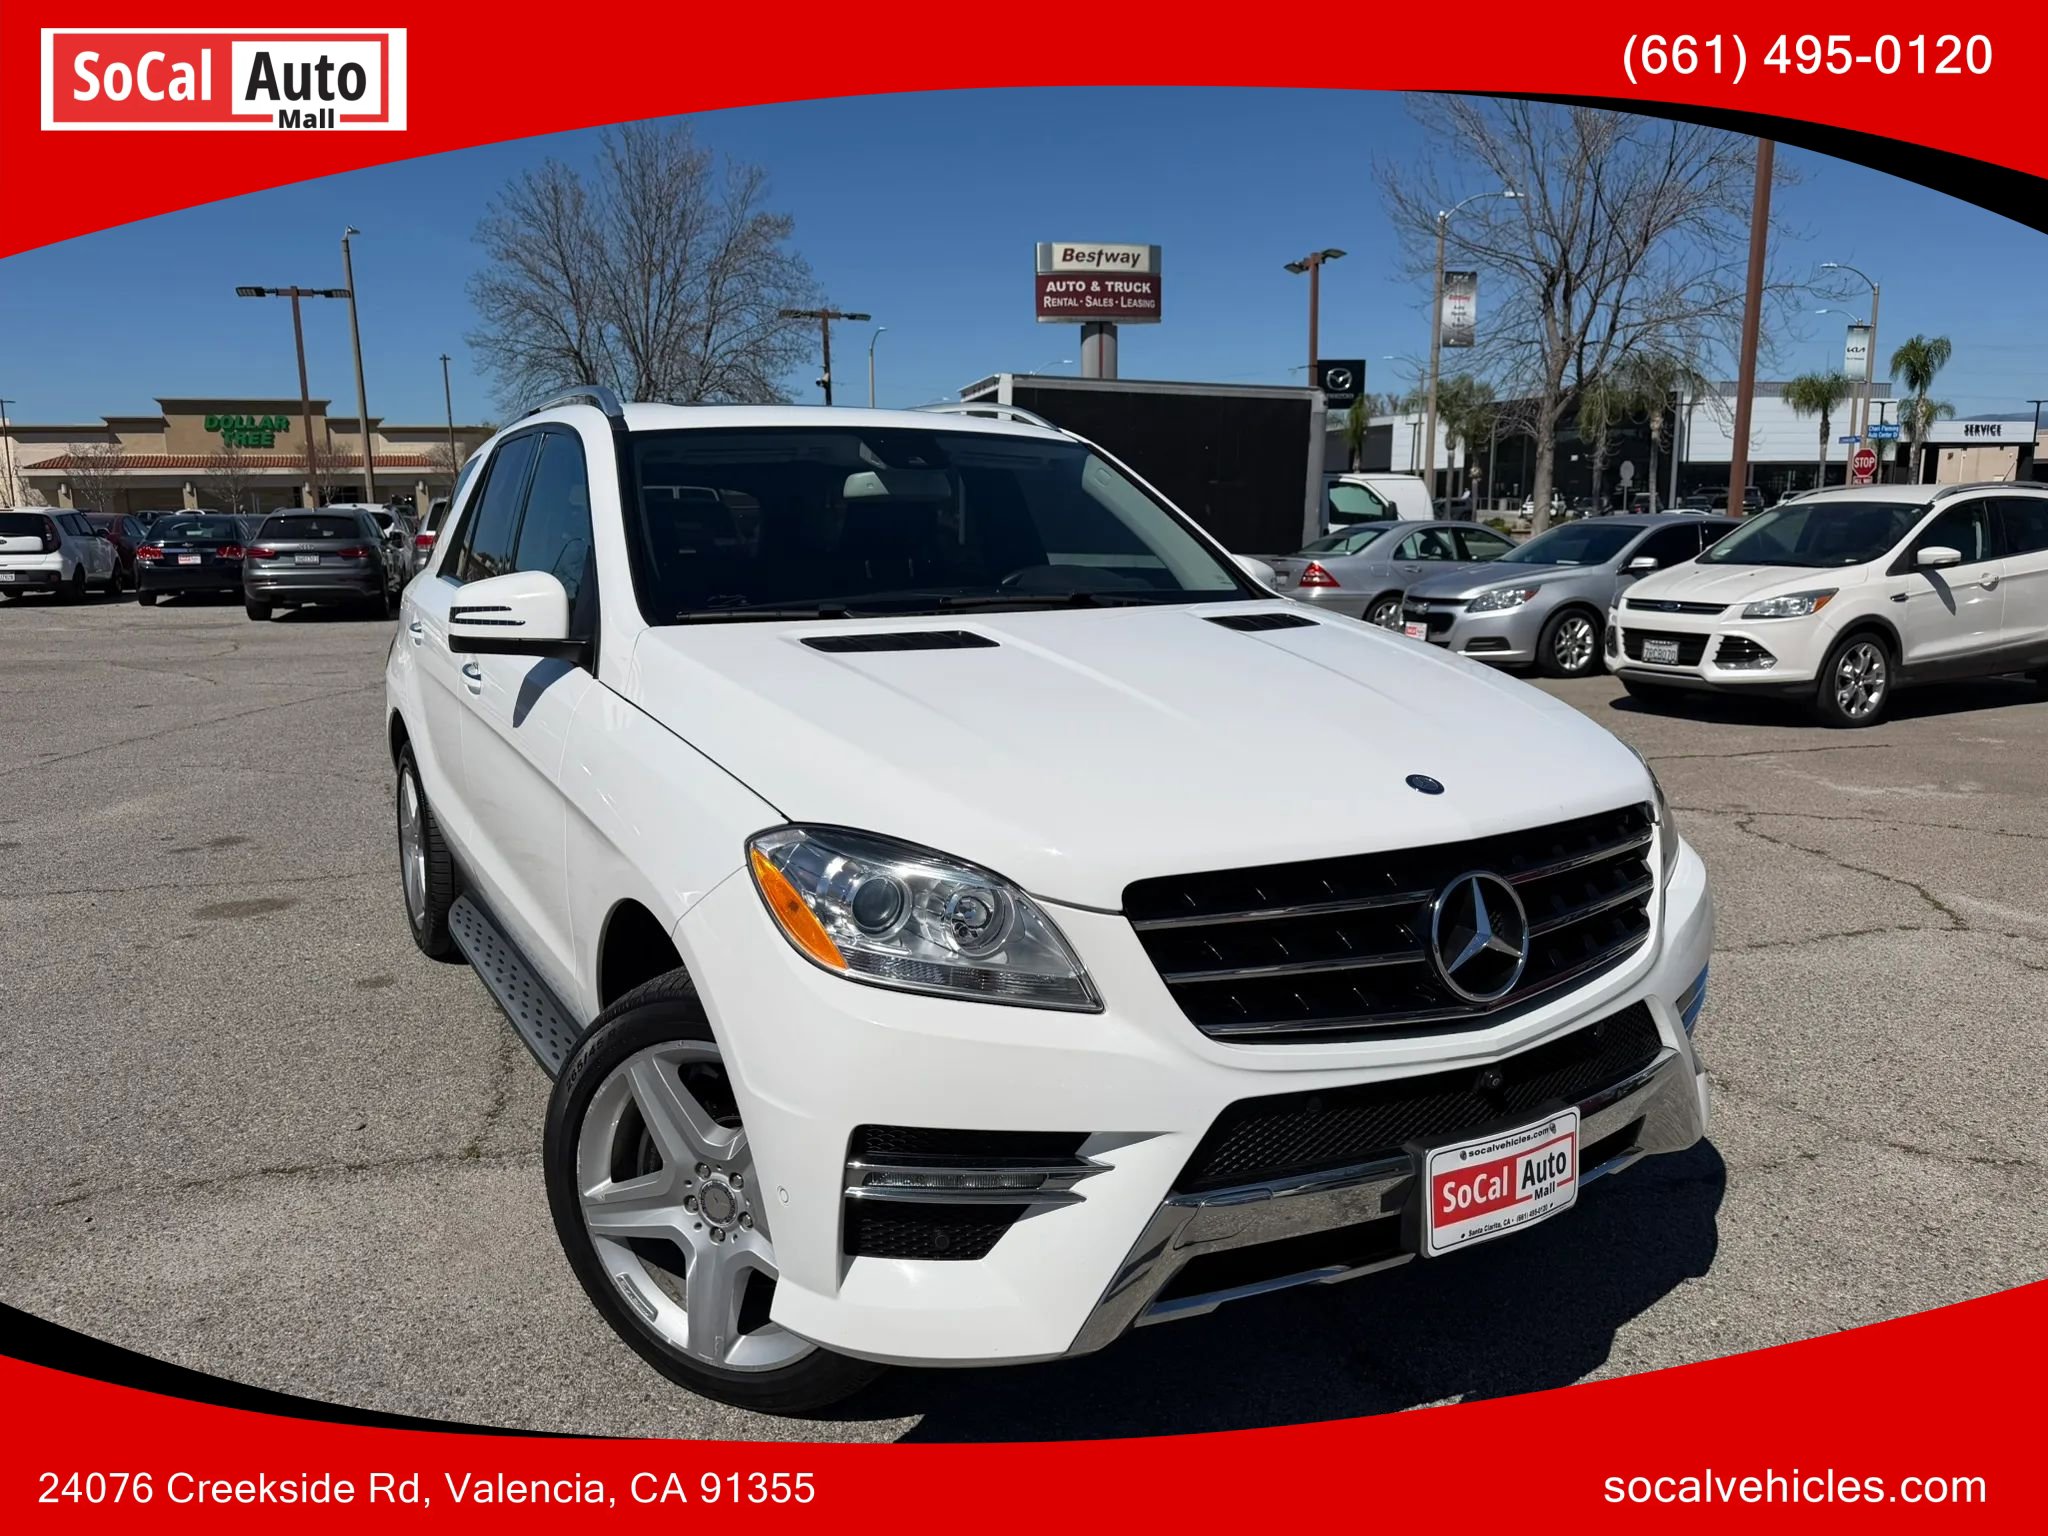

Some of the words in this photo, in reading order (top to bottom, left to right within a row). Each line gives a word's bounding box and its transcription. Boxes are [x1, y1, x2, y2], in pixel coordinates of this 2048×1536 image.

[1061, 247, 1141, 268] Bestway
[1046, 281, 1086, 293] AUTO
[1090, 281, 1101, 292] &
[1105, 281, 1151, 294] TRUCK
[204, 414, 291, 433] DOLLAR
[1963, 423, 2003, 438] SERVICE
[221, 431, 276, 449] TREE
[1854, 456, 1876, 469] STOP
[1468, 1128, 1549, 1158] socalvehicles.com
[1442, 1165, 1509, 1213] SoCal
[1521, 1151, 1567, 1190] Auto
[1534, 1181, 1556, 1201] Mall
